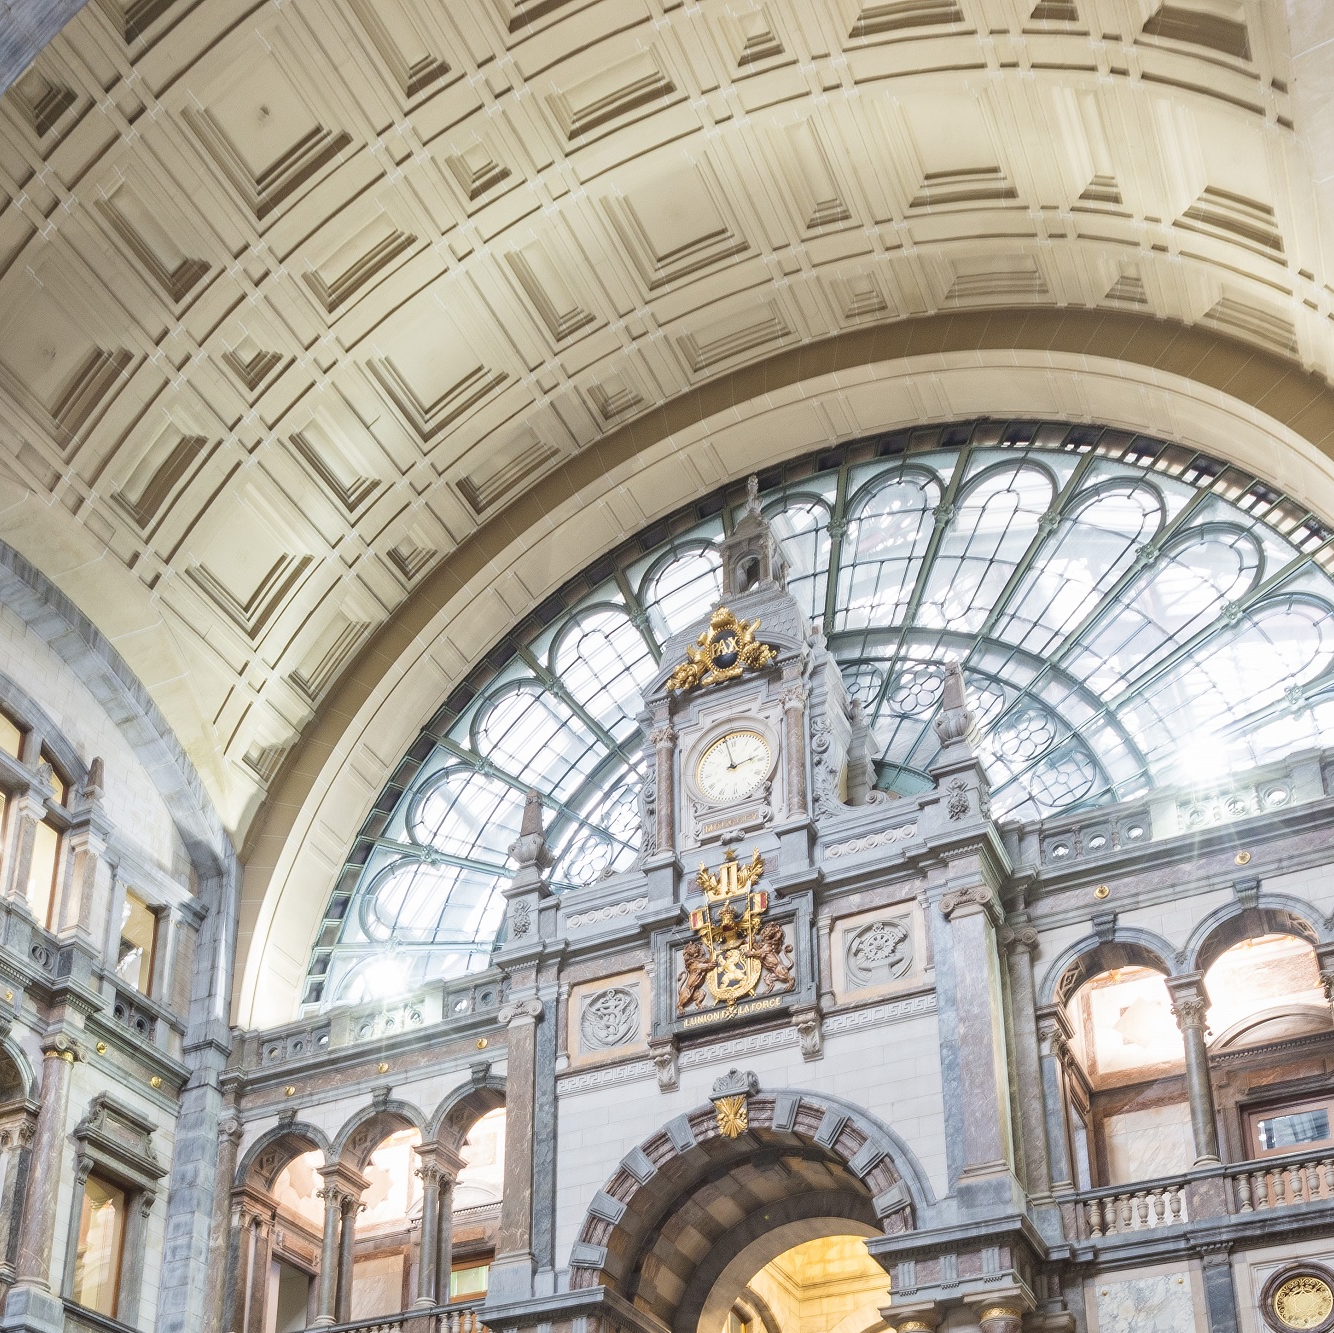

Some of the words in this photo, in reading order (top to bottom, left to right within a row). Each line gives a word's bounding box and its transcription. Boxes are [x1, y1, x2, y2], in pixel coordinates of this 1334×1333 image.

[711, 637, 740, 657] PAX
[738, 1005, 750, 1016] LA
[751, 997, 781, 1011] FORCE
